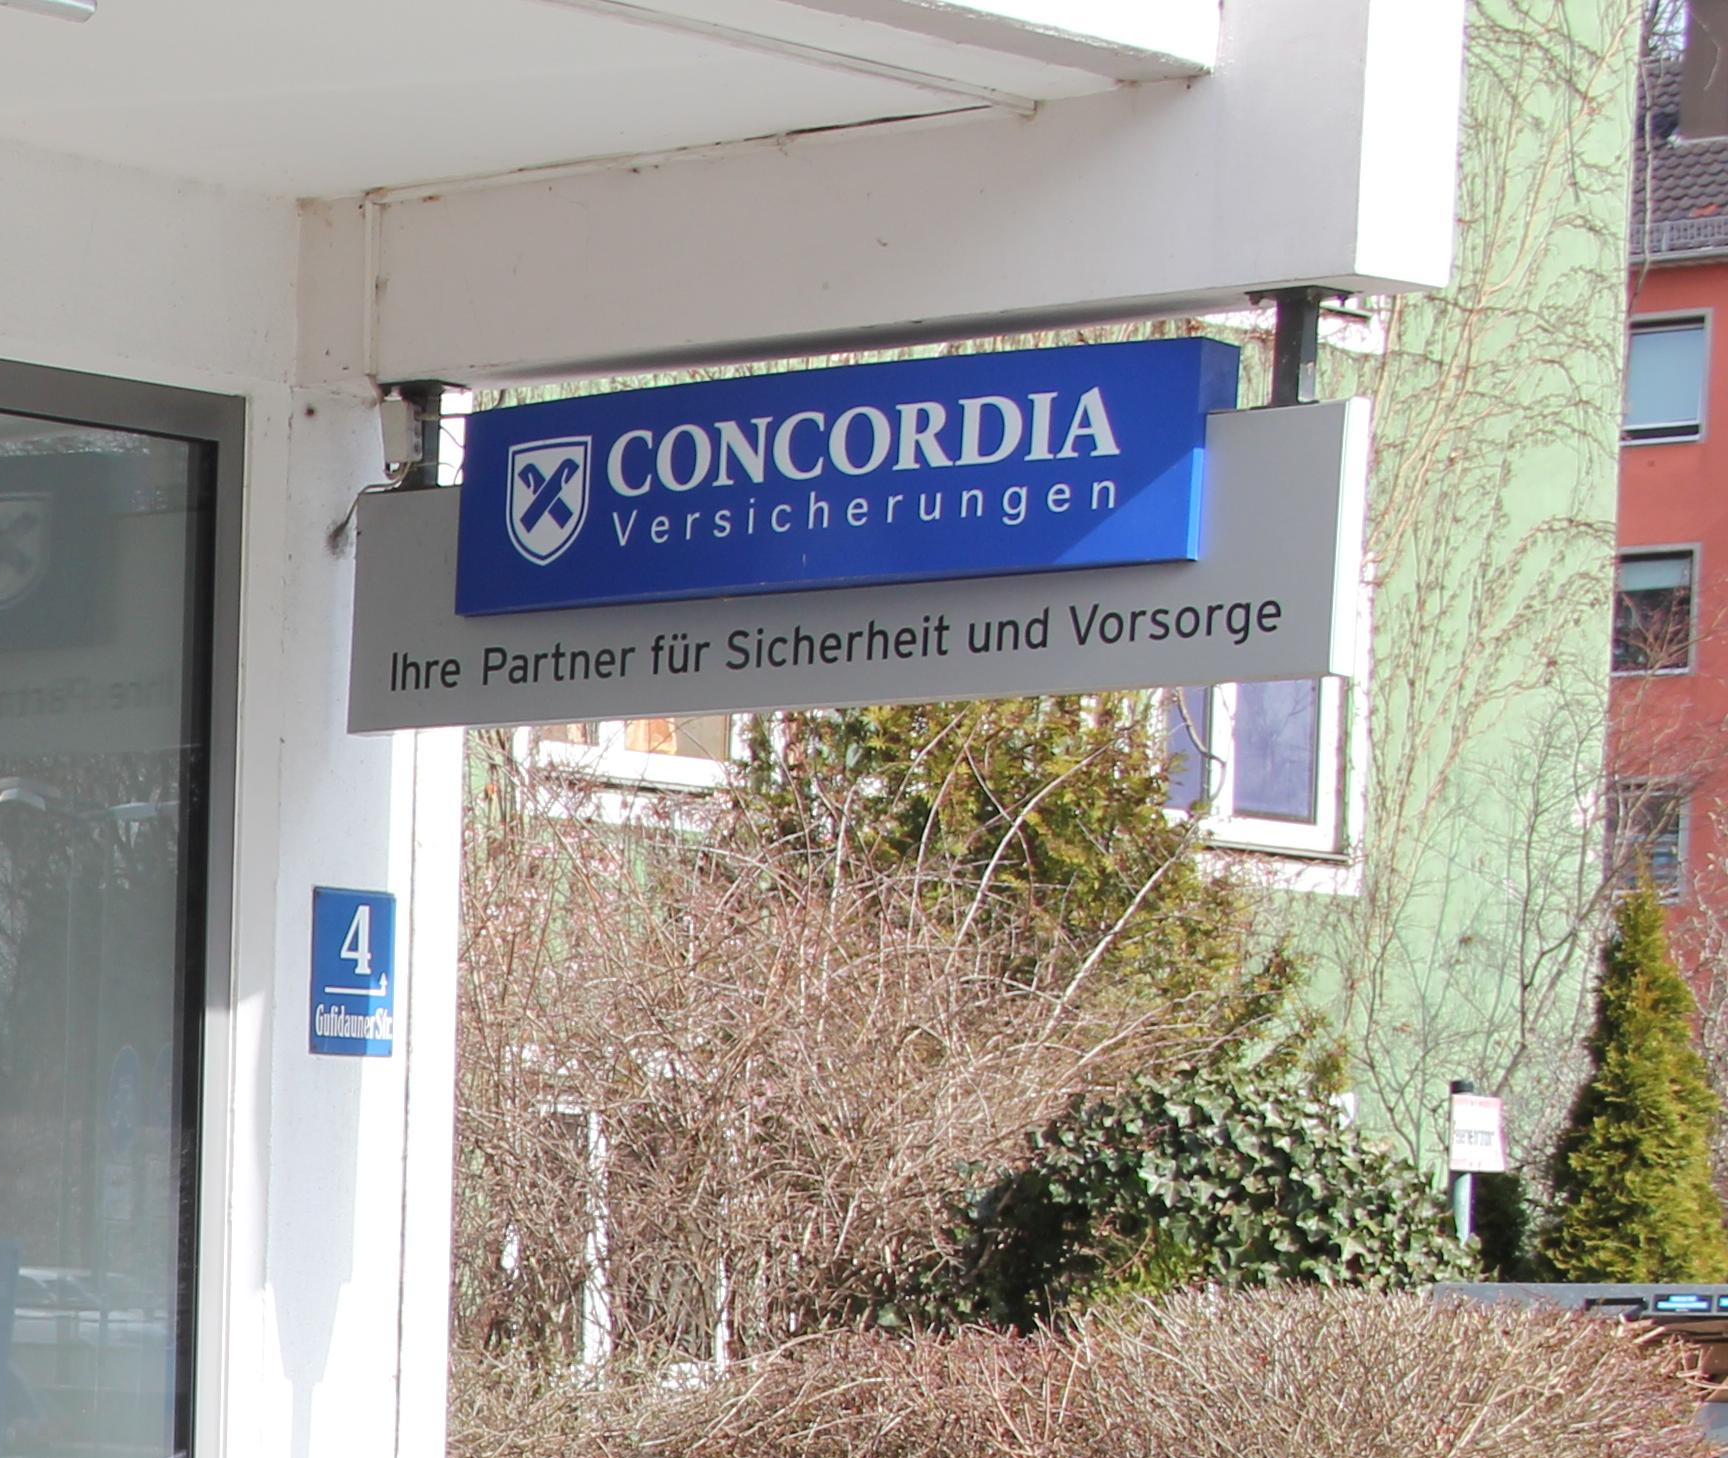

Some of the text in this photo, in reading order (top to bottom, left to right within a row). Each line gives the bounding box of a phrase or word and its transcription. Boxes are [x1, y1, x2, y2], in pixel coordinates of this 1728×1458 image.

[605, 386, 1121, 499] CONCORDIA
[609, 478, 1117, 546] Versicherungen
[390, 598, 1282, 692] Ihre Partner für Sicherheit und Vorsorge
[340, 904, 373, 975] 4
